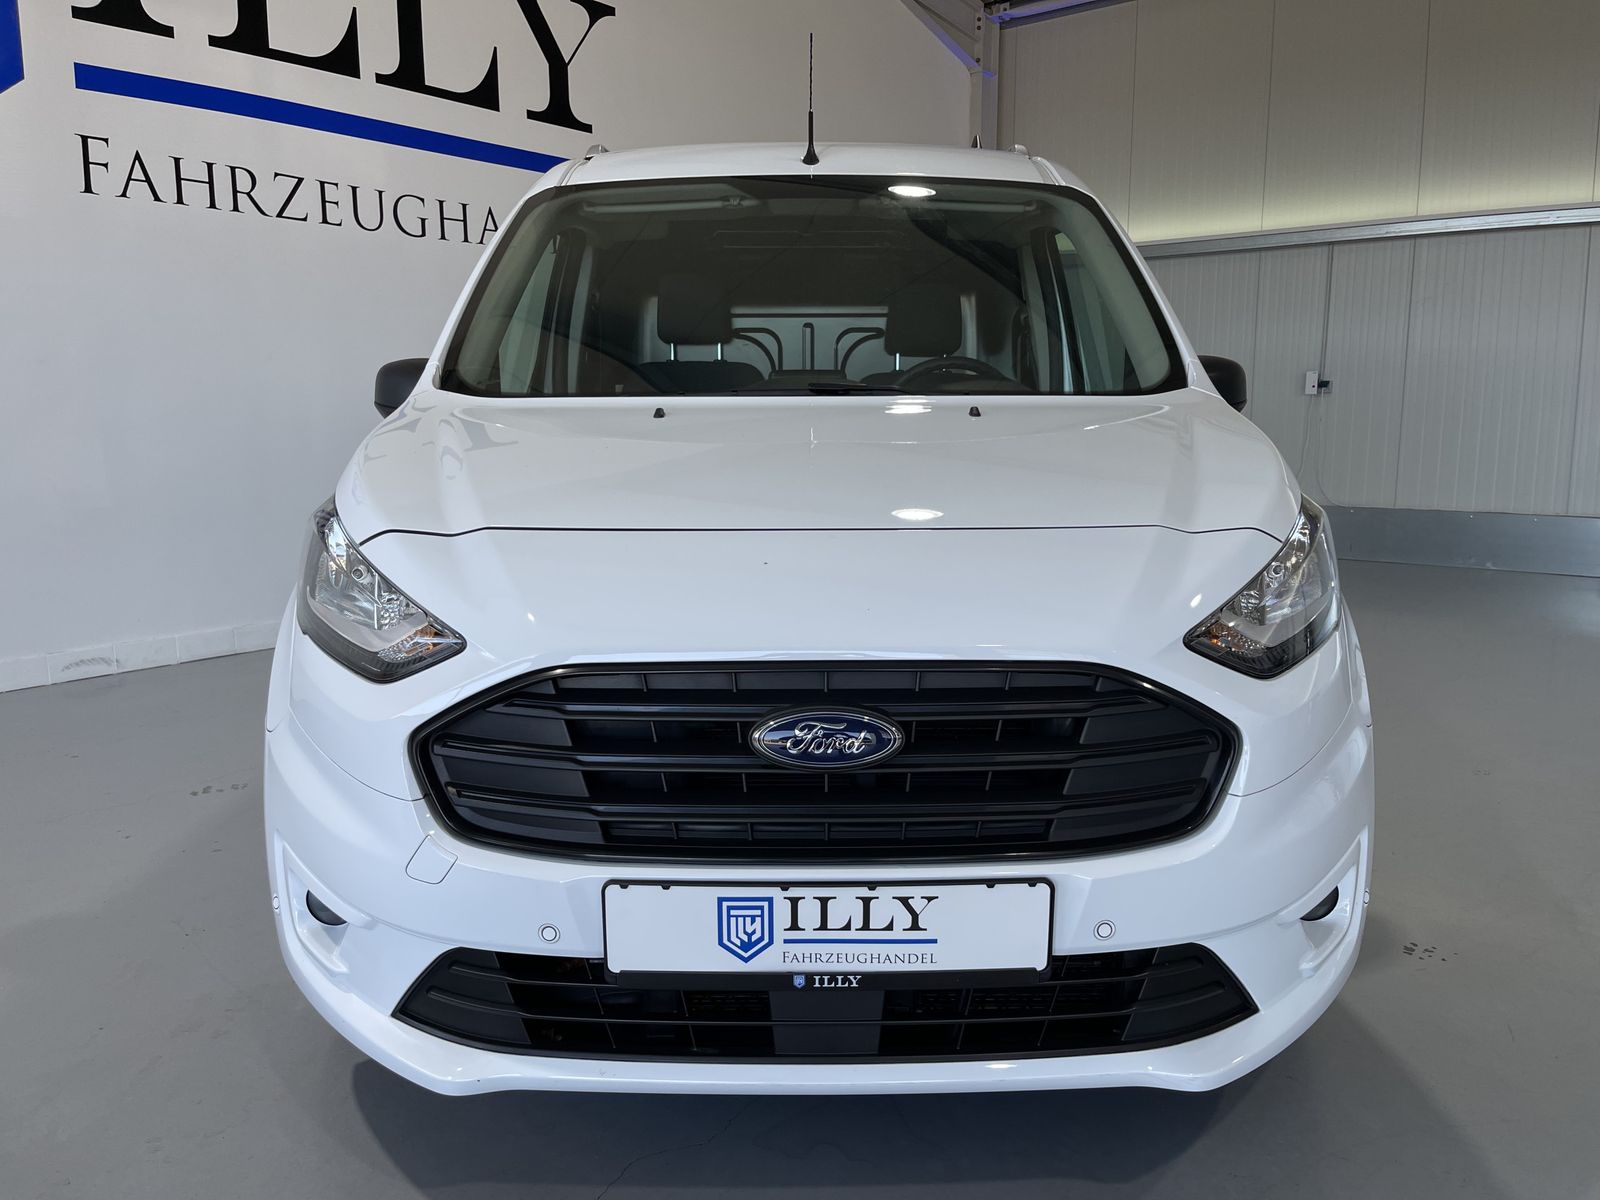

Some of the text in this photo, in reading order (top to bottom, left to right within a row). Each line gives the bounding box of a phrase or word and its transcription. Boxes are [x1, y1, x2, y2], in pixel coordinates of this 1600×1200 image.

[786, 721, 868, 754] Ford
[783, 896, 939, 932] ILLY
[782, 951, 938, 964] FAHRZEUGHANDEL
[813, 975, 862, 988] ILLY
